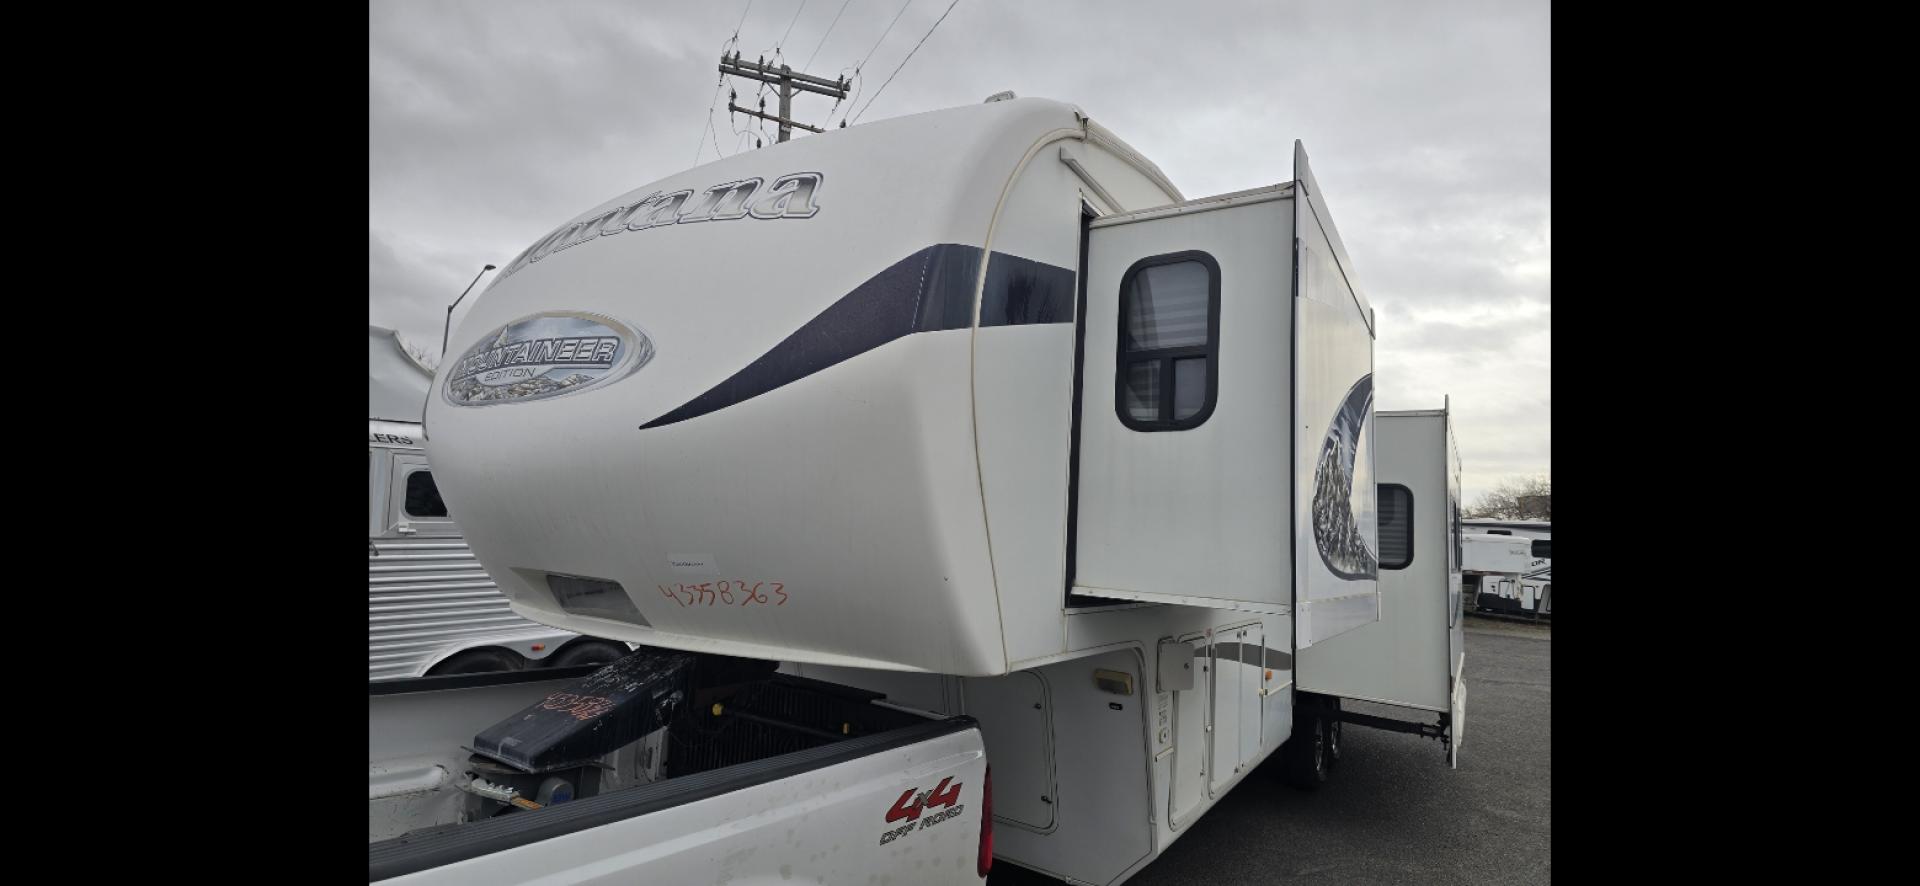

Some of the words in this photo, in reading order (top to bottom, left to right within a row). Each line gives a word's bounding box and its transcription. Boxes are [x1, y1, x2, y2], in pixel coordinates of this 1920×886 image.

[484, 367, 536, 382] EDITION
[879, 821, 918, 846] OFF
[919, 804, 965, 830] ROAD
